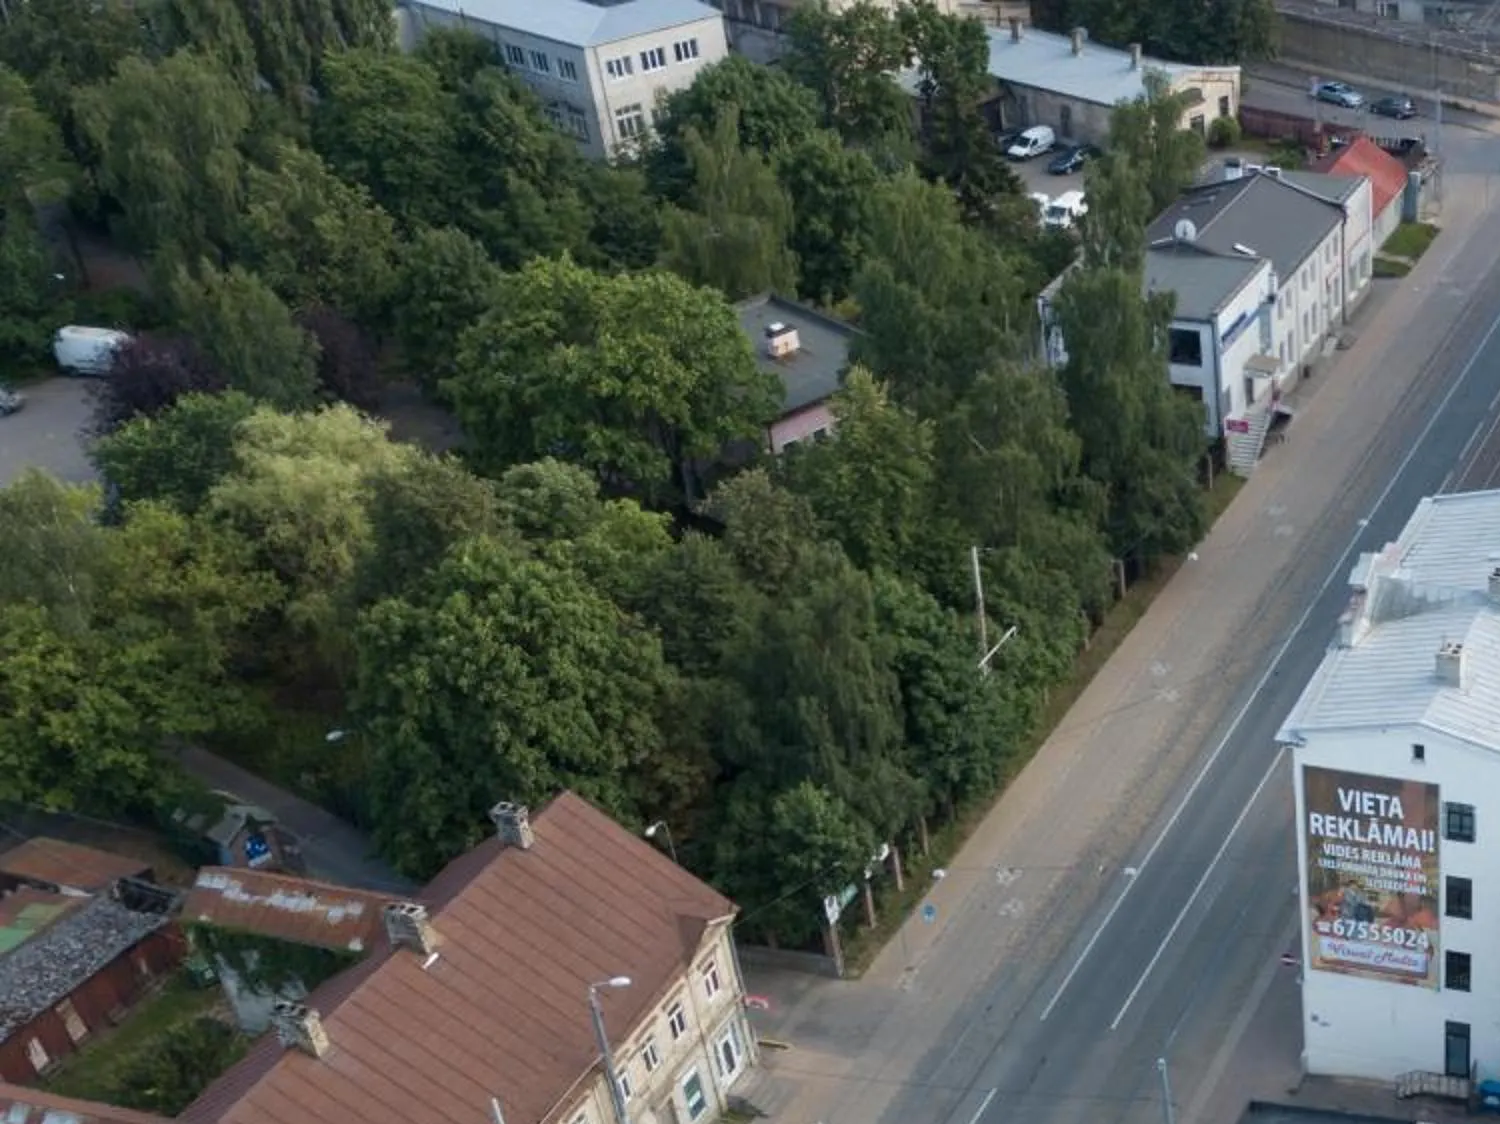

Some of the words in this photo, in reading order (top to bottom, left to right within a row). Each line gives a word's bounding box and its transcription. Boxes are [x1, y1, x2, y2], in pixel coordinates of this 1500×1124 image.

[1337, 788, 1404, 819] VIETA
[1310, 812, 1435, 853] REKLĀMAI!
[1323, 843, 1360, 861] VIDES
[1333, 918, 1429, 948] 67555024
